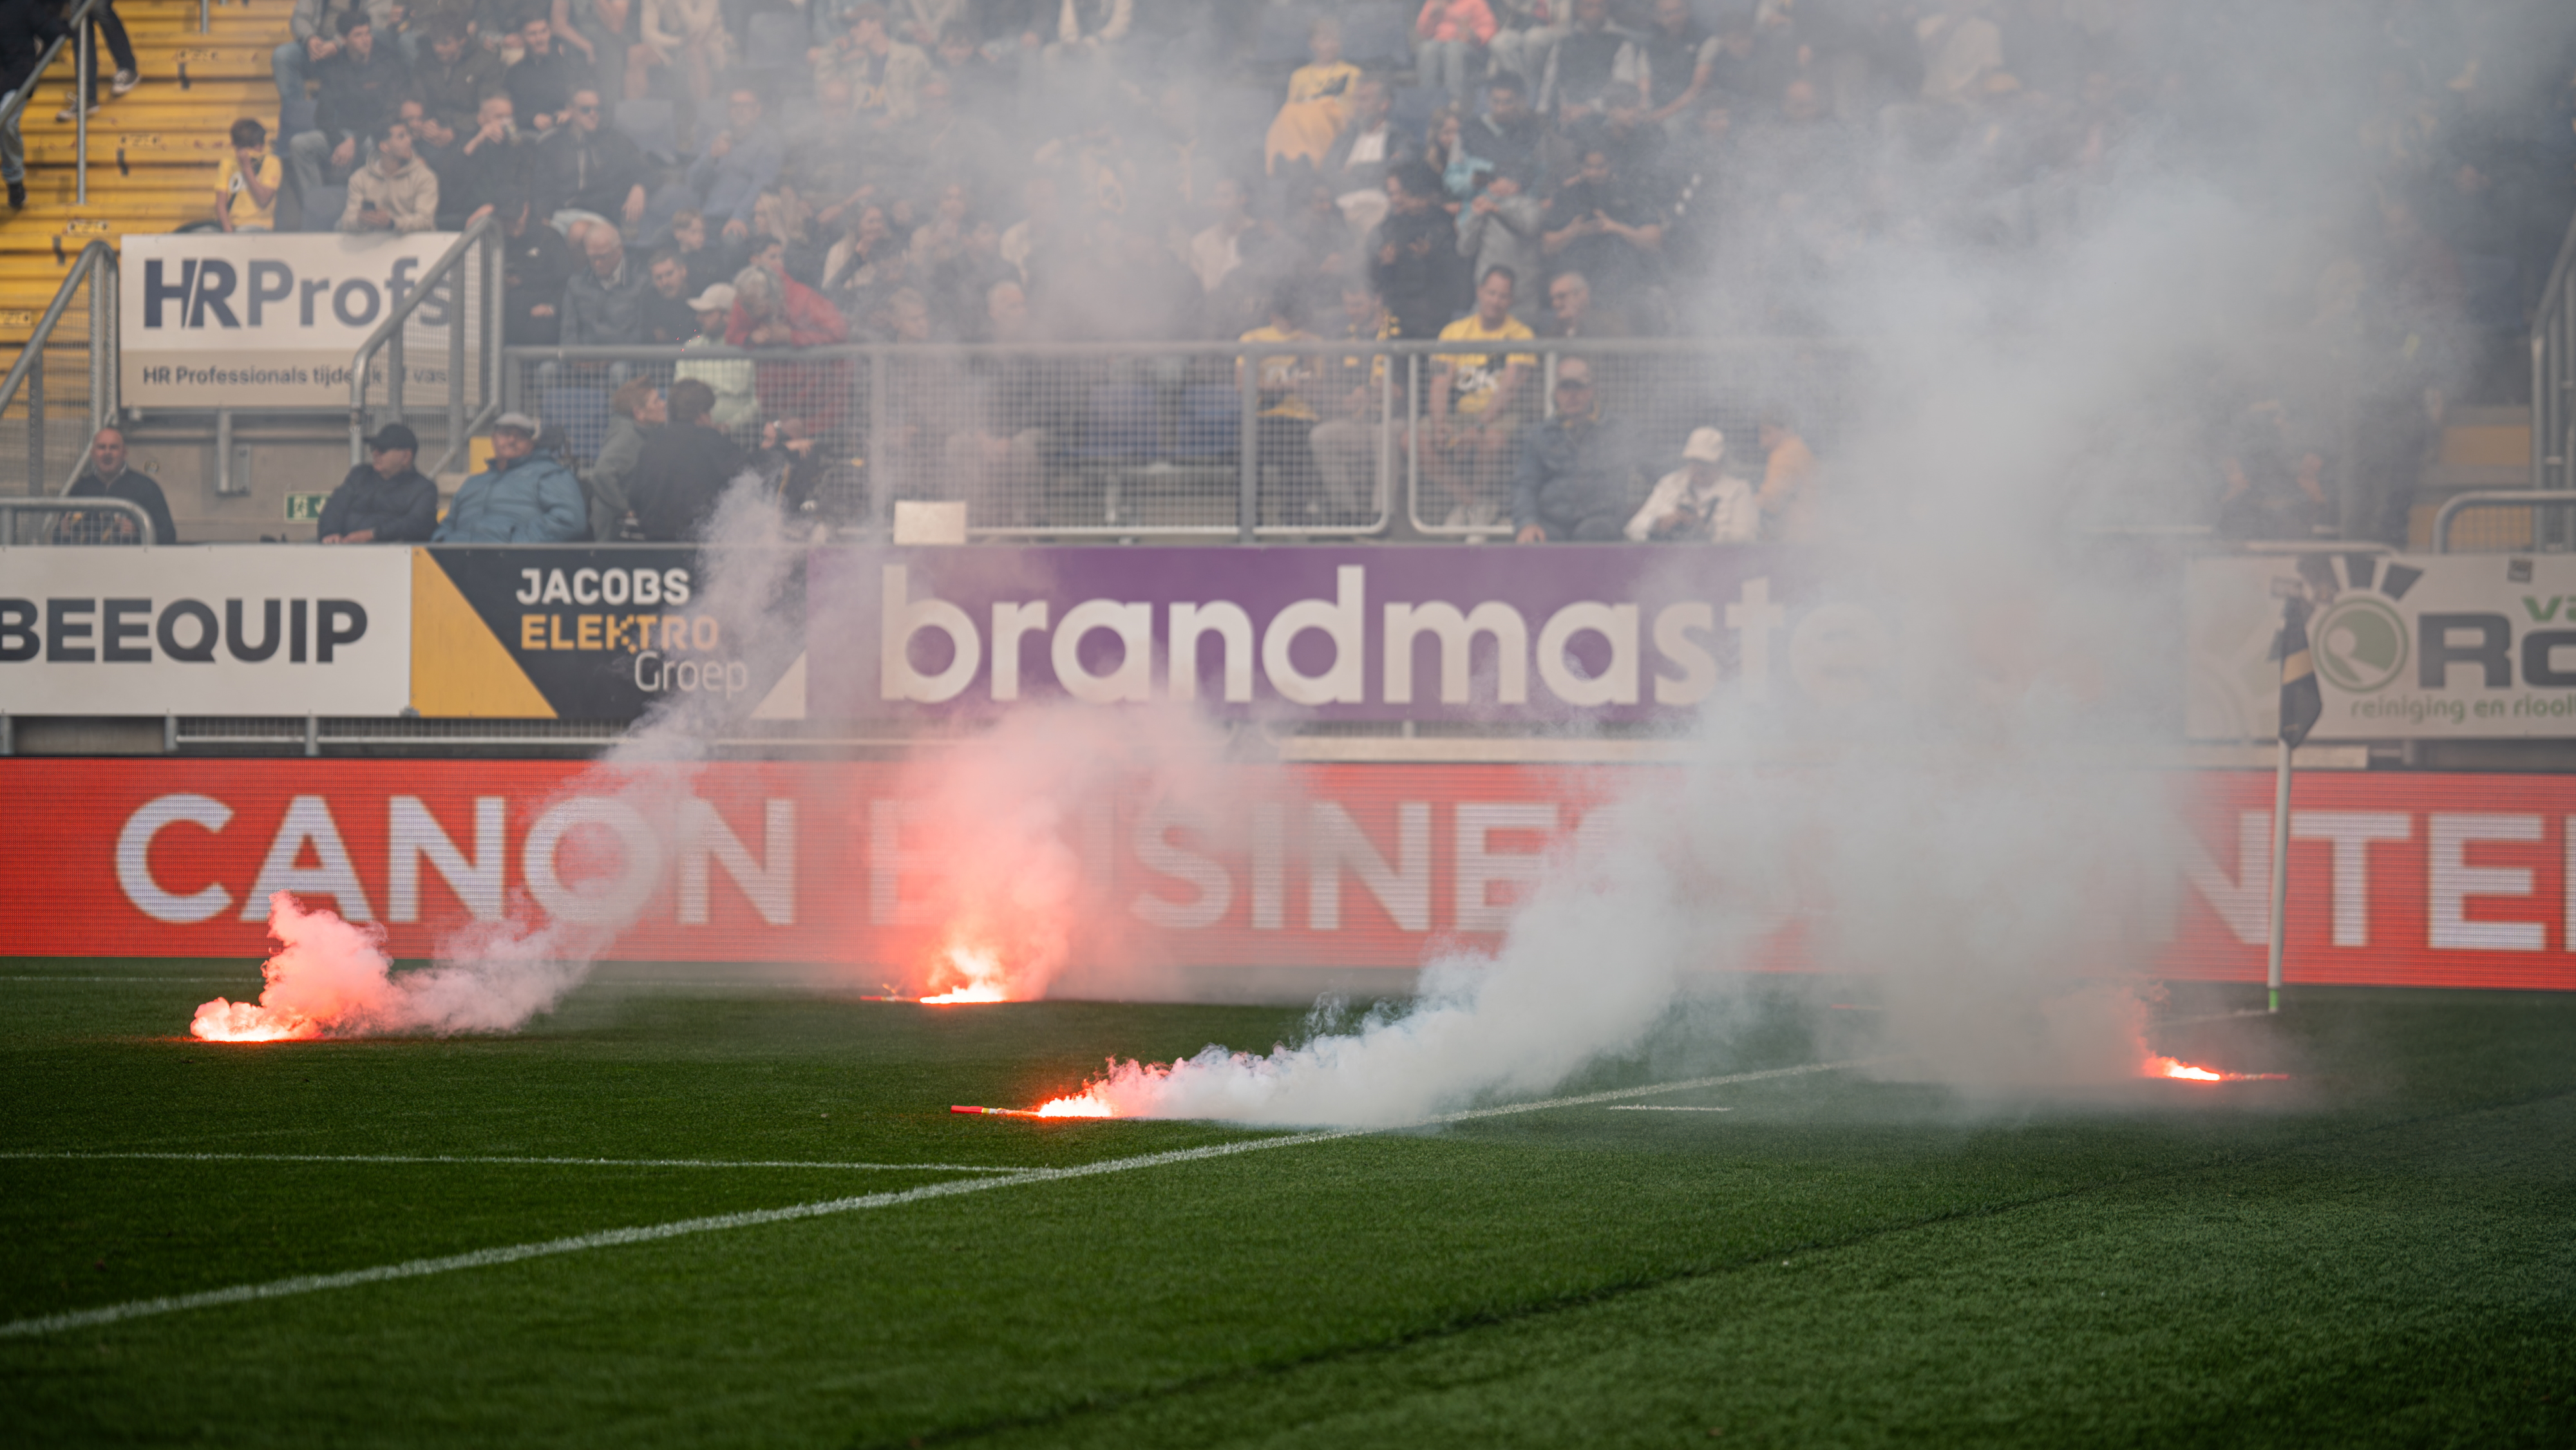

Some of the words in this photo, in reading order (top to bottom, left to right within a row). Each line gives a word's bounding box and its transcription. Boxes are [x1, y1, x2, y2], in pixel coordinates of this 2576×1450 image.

[143, 366, 170, 384] HR
[176, 365, 308, 384] Professionals
[413, 368, 453, 384] vas
[516, 567, 690, 606] JACOBS
[0, 598, 368, 664] BEEQUIP
[521, 613, 719, 654] ELEKTRO
[880, 564, 1887, 707] brandmaste
[634, 649, 750, 701] Groep
[2351, 694, 2465, 725] reiniging
[2473, 697, 2505, 718] en
[116, 793, 797, 925] CANON
